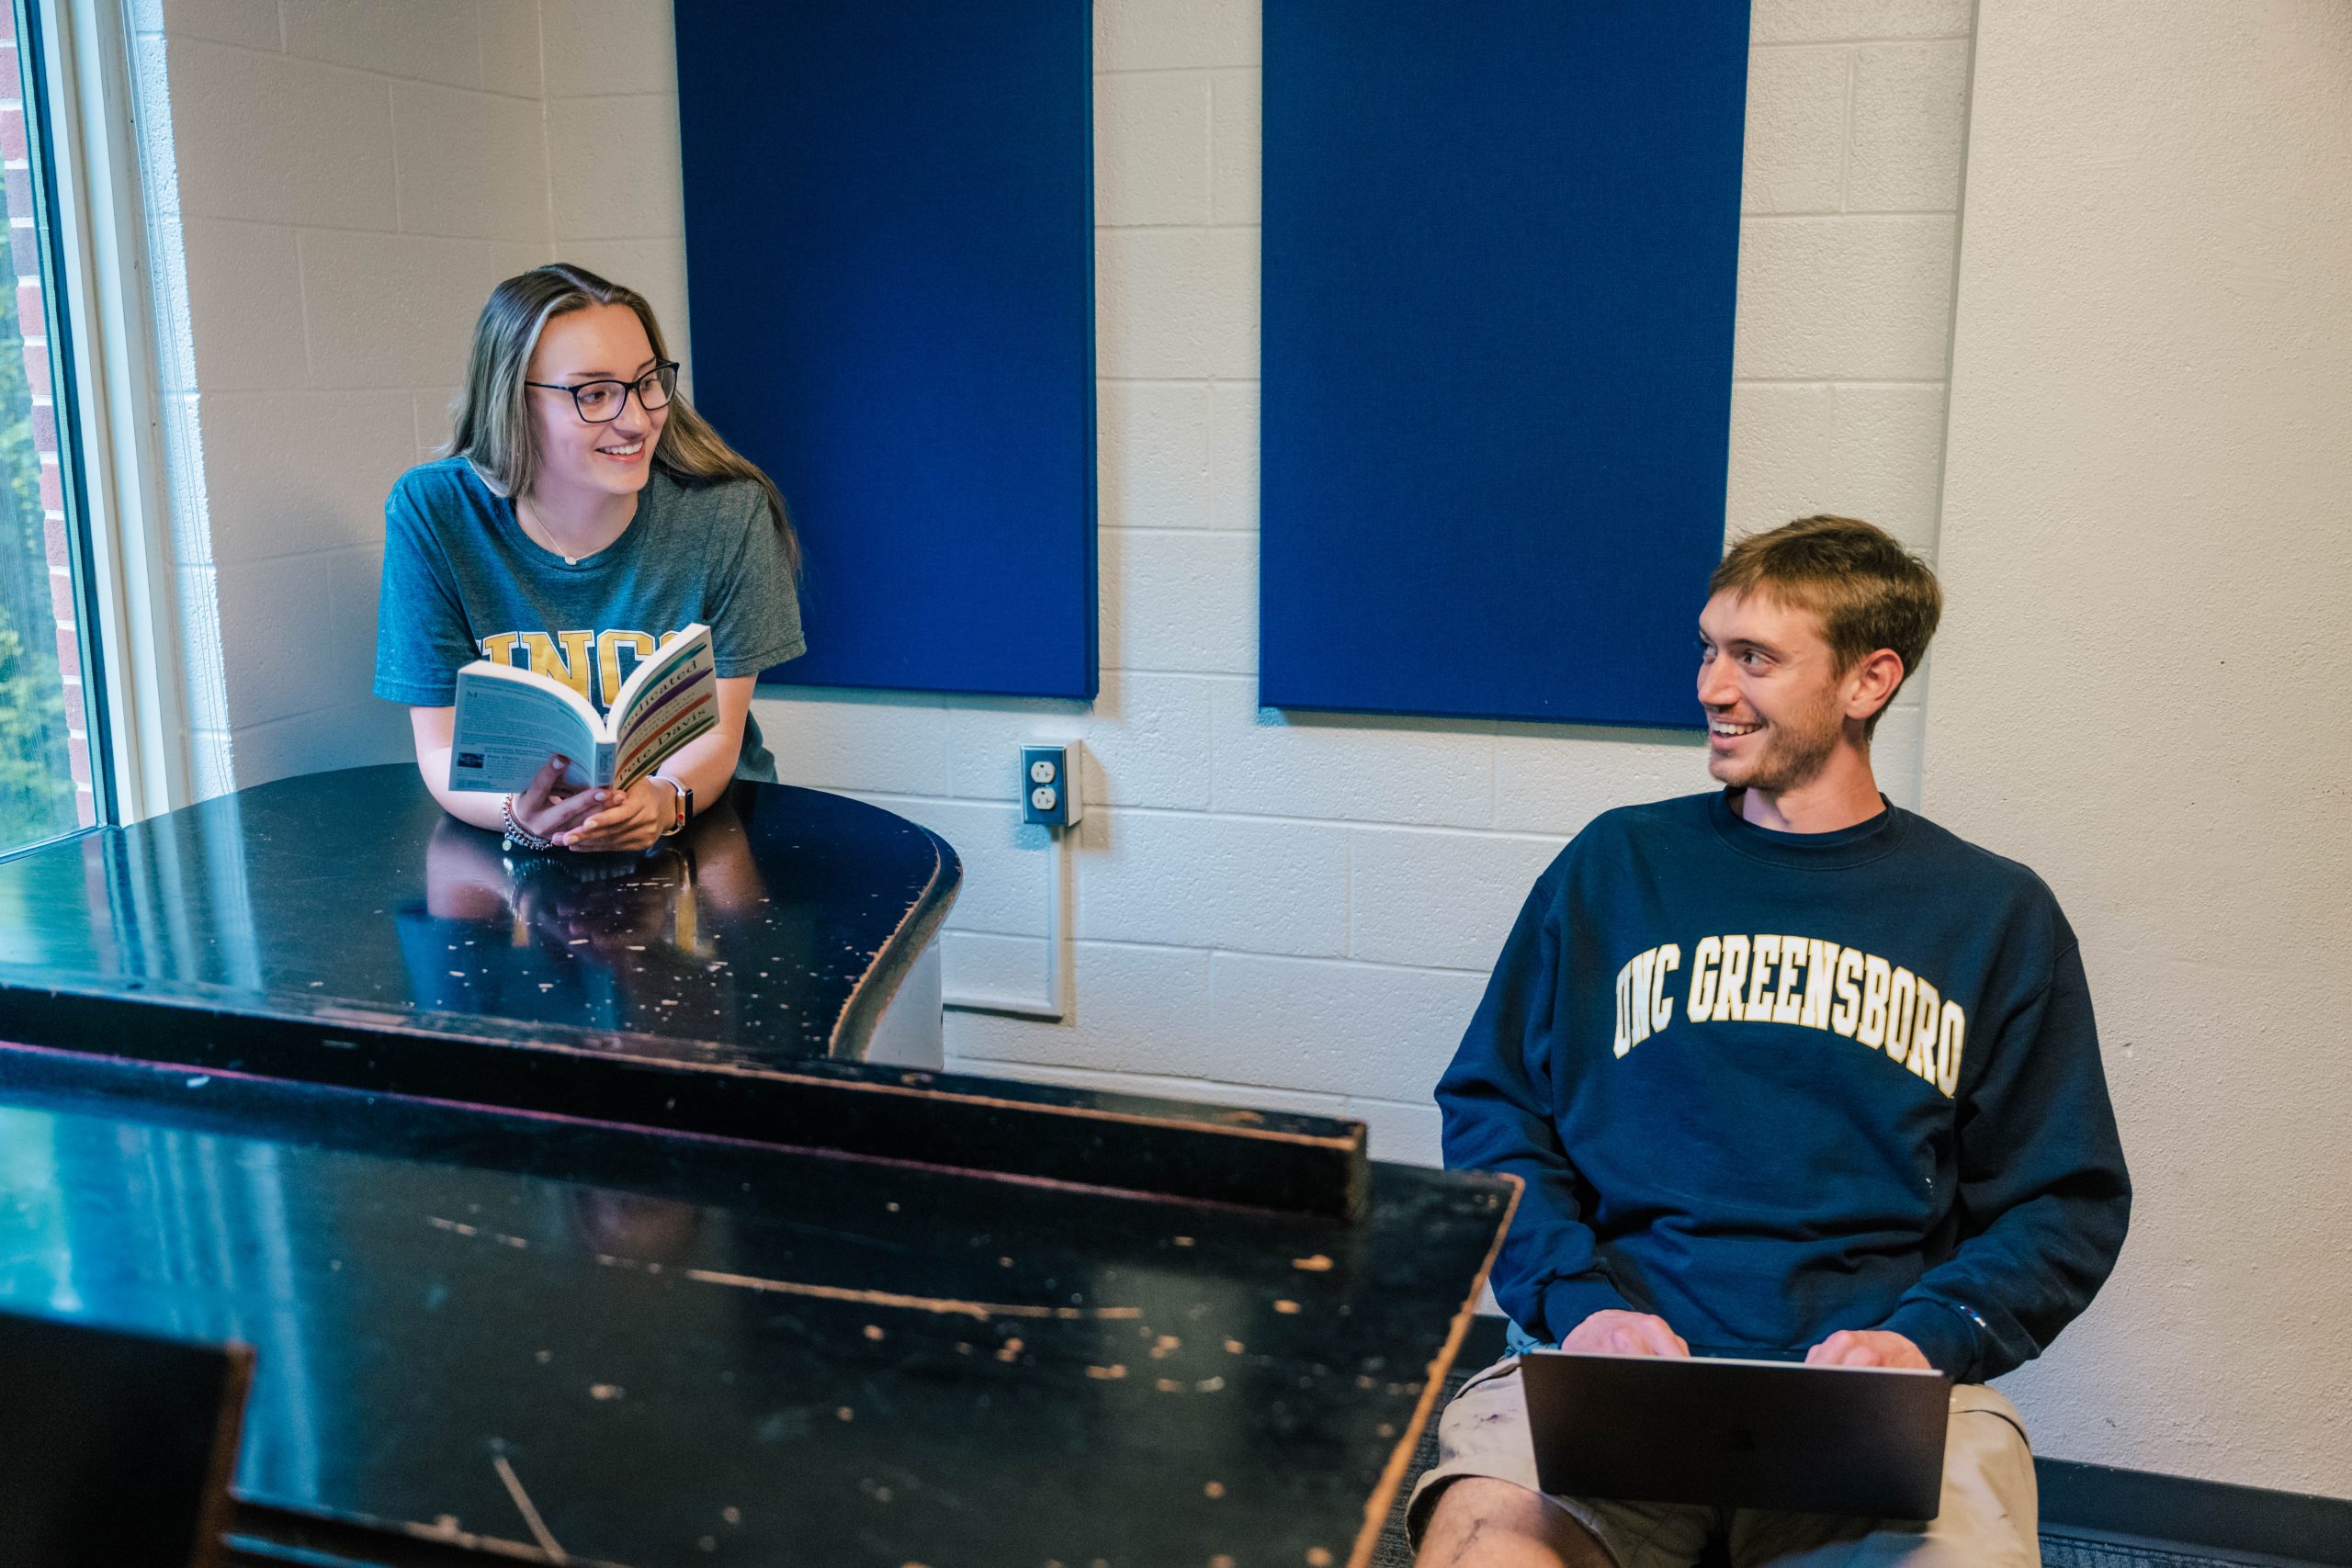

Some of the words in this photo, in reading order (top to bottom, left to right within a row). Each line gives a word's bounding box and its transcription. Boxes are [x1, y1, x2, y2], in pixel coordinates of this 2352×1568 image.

[658, 708, 707, 746] Davis
[1613, 943, 1680, 1059] UNC
[1687, 933, 1966, 1099] GREENSBORO
